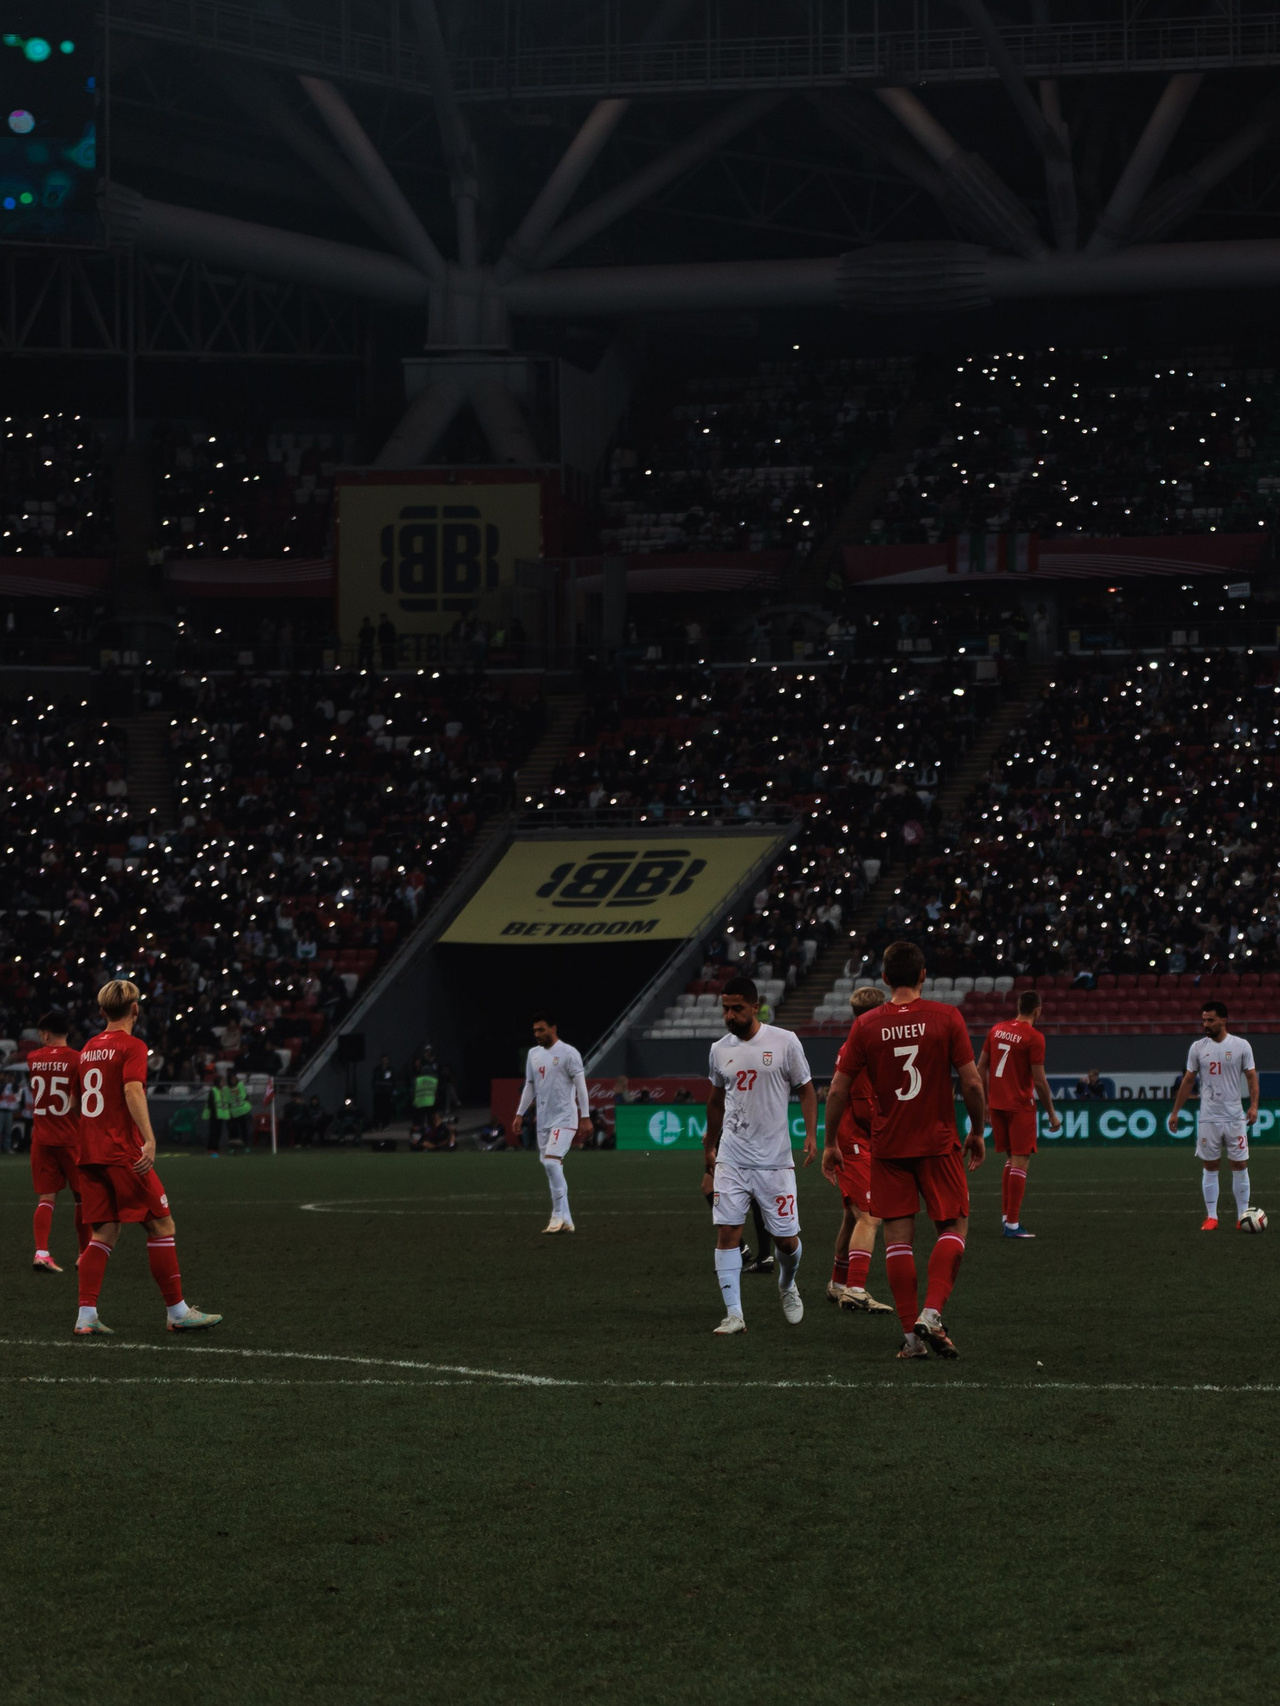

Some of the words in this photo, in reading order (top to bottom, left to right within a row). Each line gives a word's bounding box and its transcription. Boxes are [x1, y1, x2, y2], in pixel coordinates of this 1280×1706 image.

[501, 919, 660, 936] BETBOOM
[881, 1023, 926, 1041] DIVEEV
[995, 1030, 1022, 1043] SOBOLEV
[32, 1061, 68, 1072] PRUTSEV
[995, 1043, 1011, 1077] 7
[1210, 1062, 1222, 1075] 21
[539, 1066, 545, 1079] 4
[737, 1070, 757, 1091] 27
[894, 1045, 922, 1101] 3
[31, 1075, 70, 1116] 25
[81, 1068, 104, 1118] 8
[1099, 1108, 1157, 1139] СО
[553, 1128, 560, 1140] 4
[776, 1194, 794, 1216] 27
